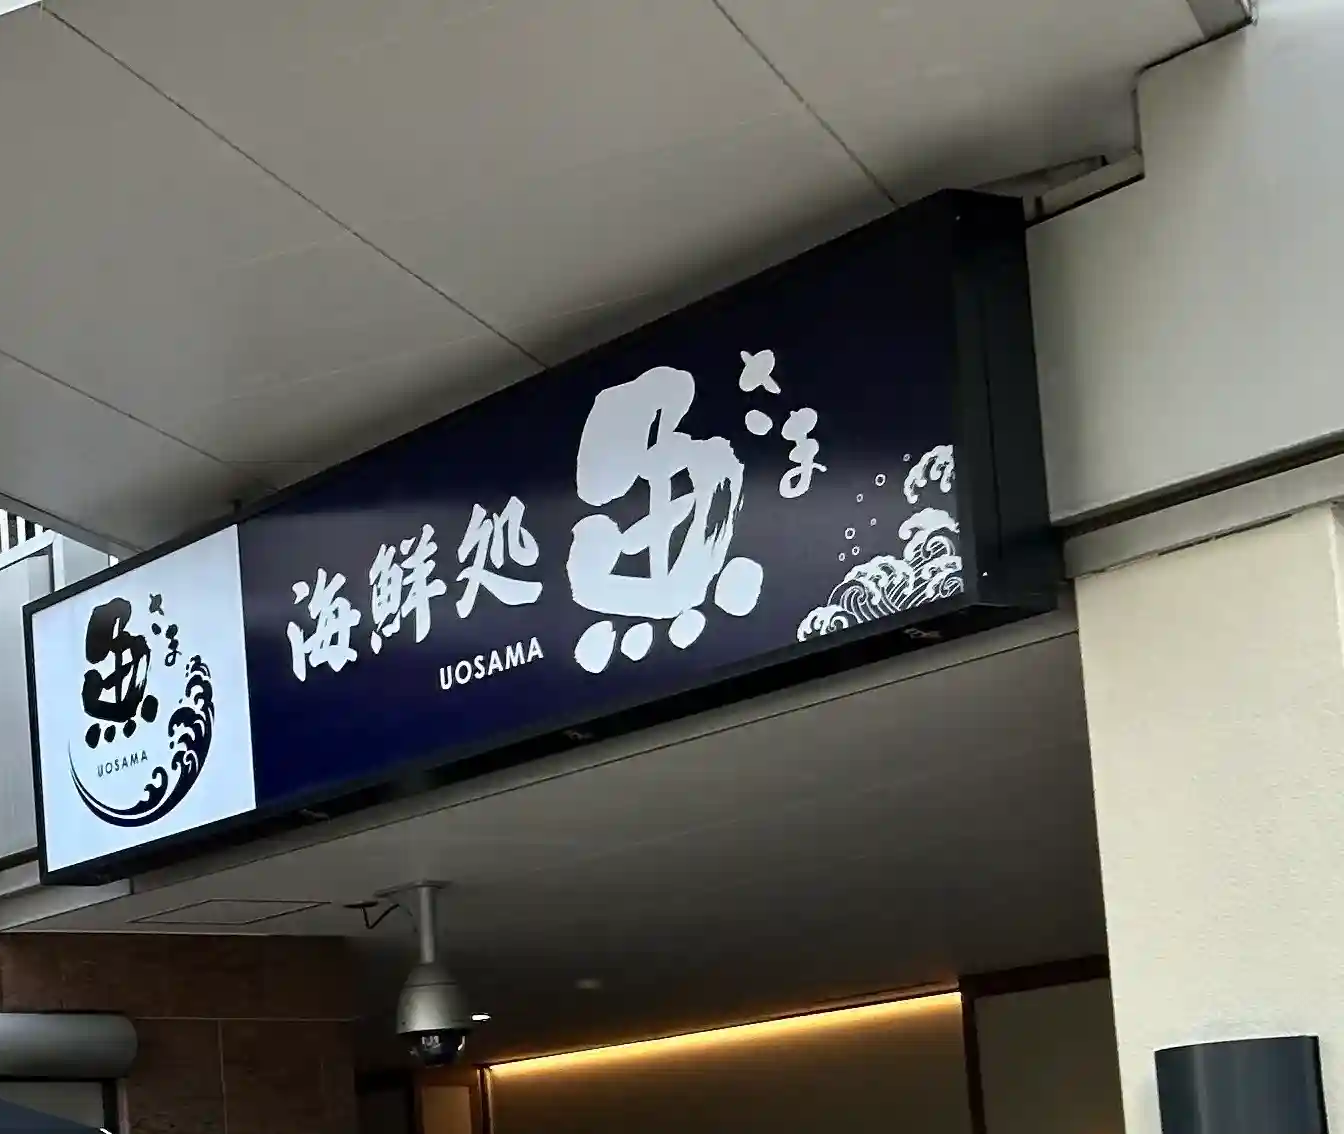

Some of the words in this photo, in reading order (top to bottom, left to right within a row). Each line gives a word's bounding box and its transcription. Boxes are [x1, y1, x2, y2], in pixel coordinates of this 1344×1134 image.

[287, 495, 544, 682] 海鮮処
[438, 638, 544, 691] UOSAMA
[96, 749, 148, 778] UOSAMA
